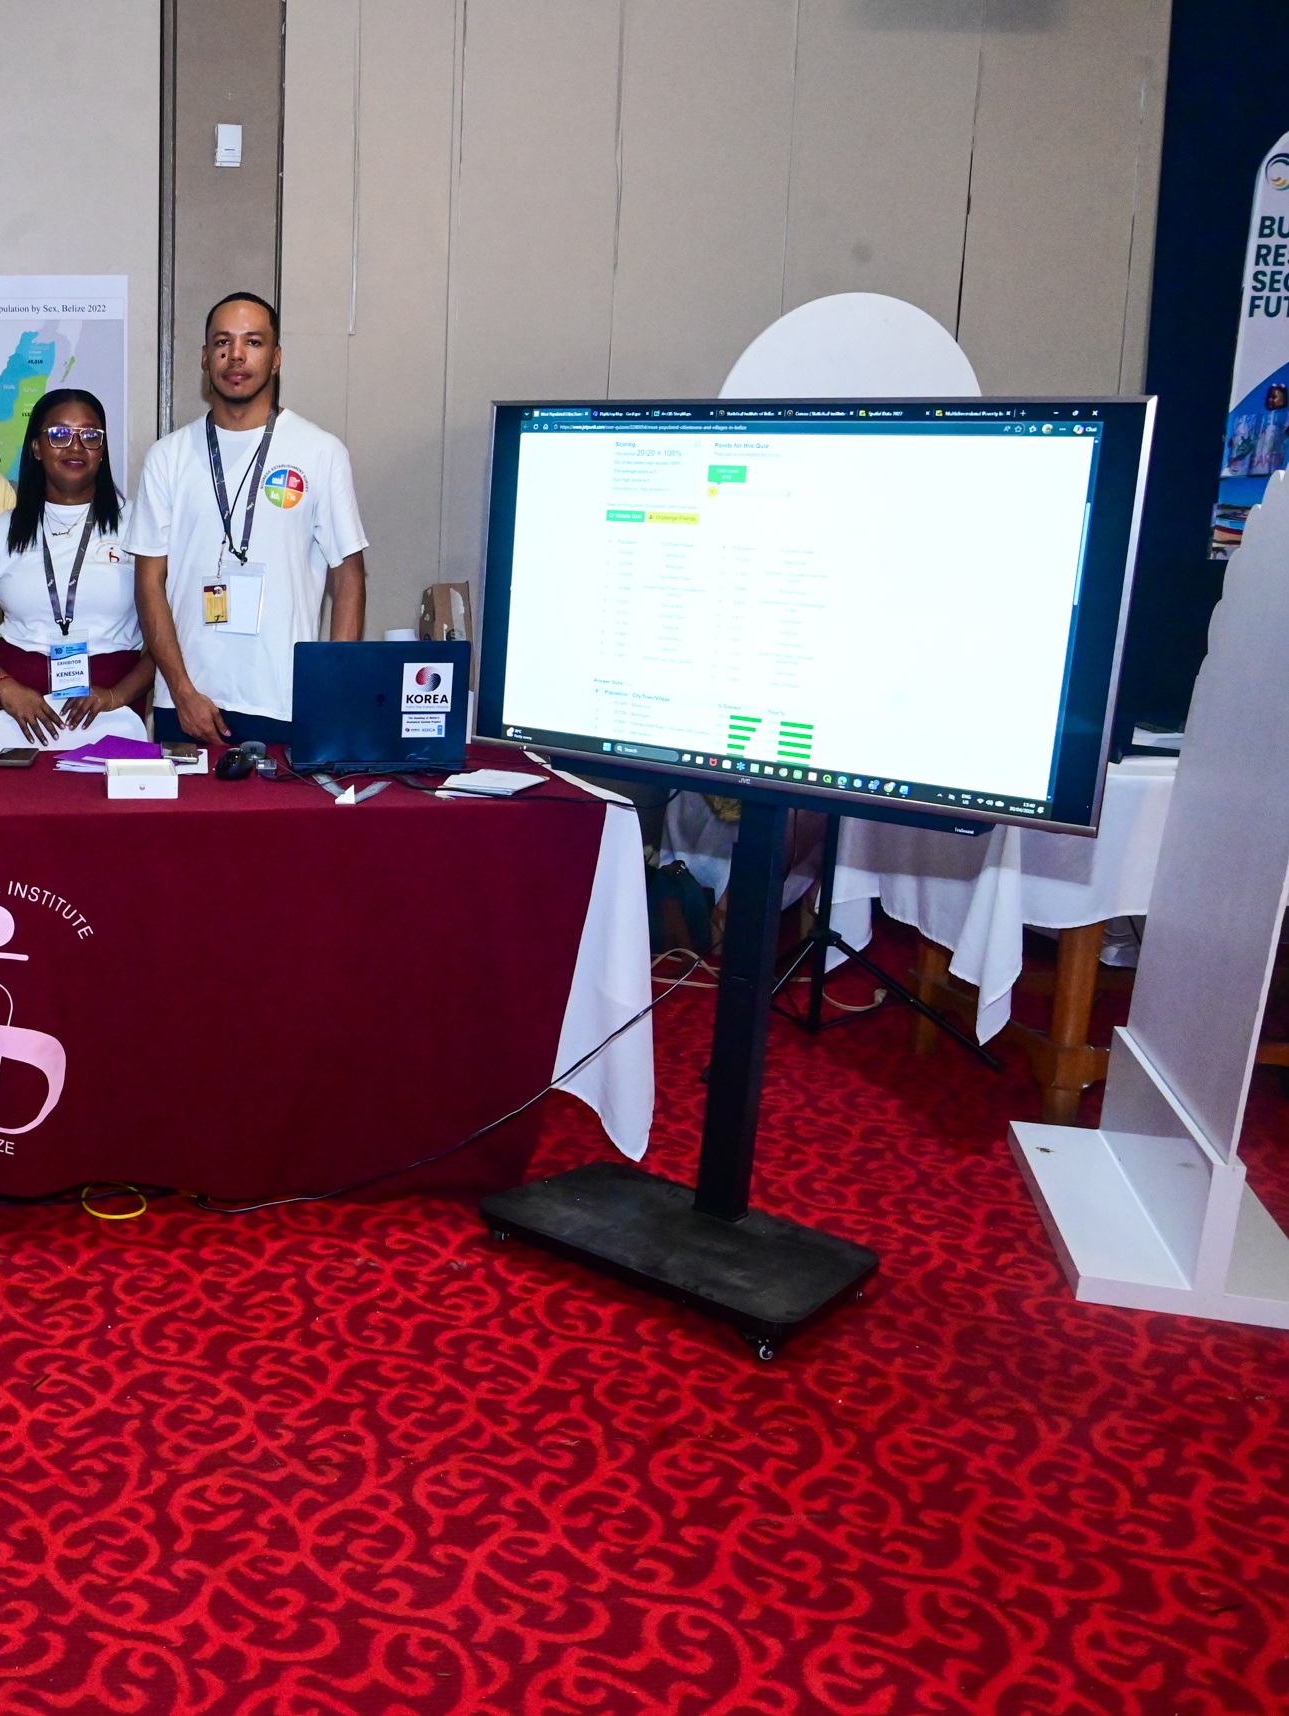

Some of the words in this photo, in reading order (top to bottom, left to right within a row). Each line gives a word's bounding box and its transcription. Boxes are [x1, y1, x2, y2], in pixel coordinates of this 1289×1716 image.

[1254, 244, 1289, 267] RE
[31, 304, 41, 314] by
[42, 304, 60, 314] Sex,
[61, 304, 86, 313] Belize
[87, 304, 106, 312] 2022
[615, 441, 636, 450] Scoring
[714, 442, 732, 450] Points
[733, 442, 742, 450] for
[743, 442, 754, 450] this
[756, 442, 769, 450] Quiz
[636, 449, 656, 457] 20/20
[663, 449, 682, 458] 100%
[656, 514, 678, 522] Challenge
[56, 670, 84, 678] KENESHA
[406, 694, 448, 704] KOREA
[632, 692, 670, 702] City/Town/Village
[8, 880, 94, 940] INSTITUTE
